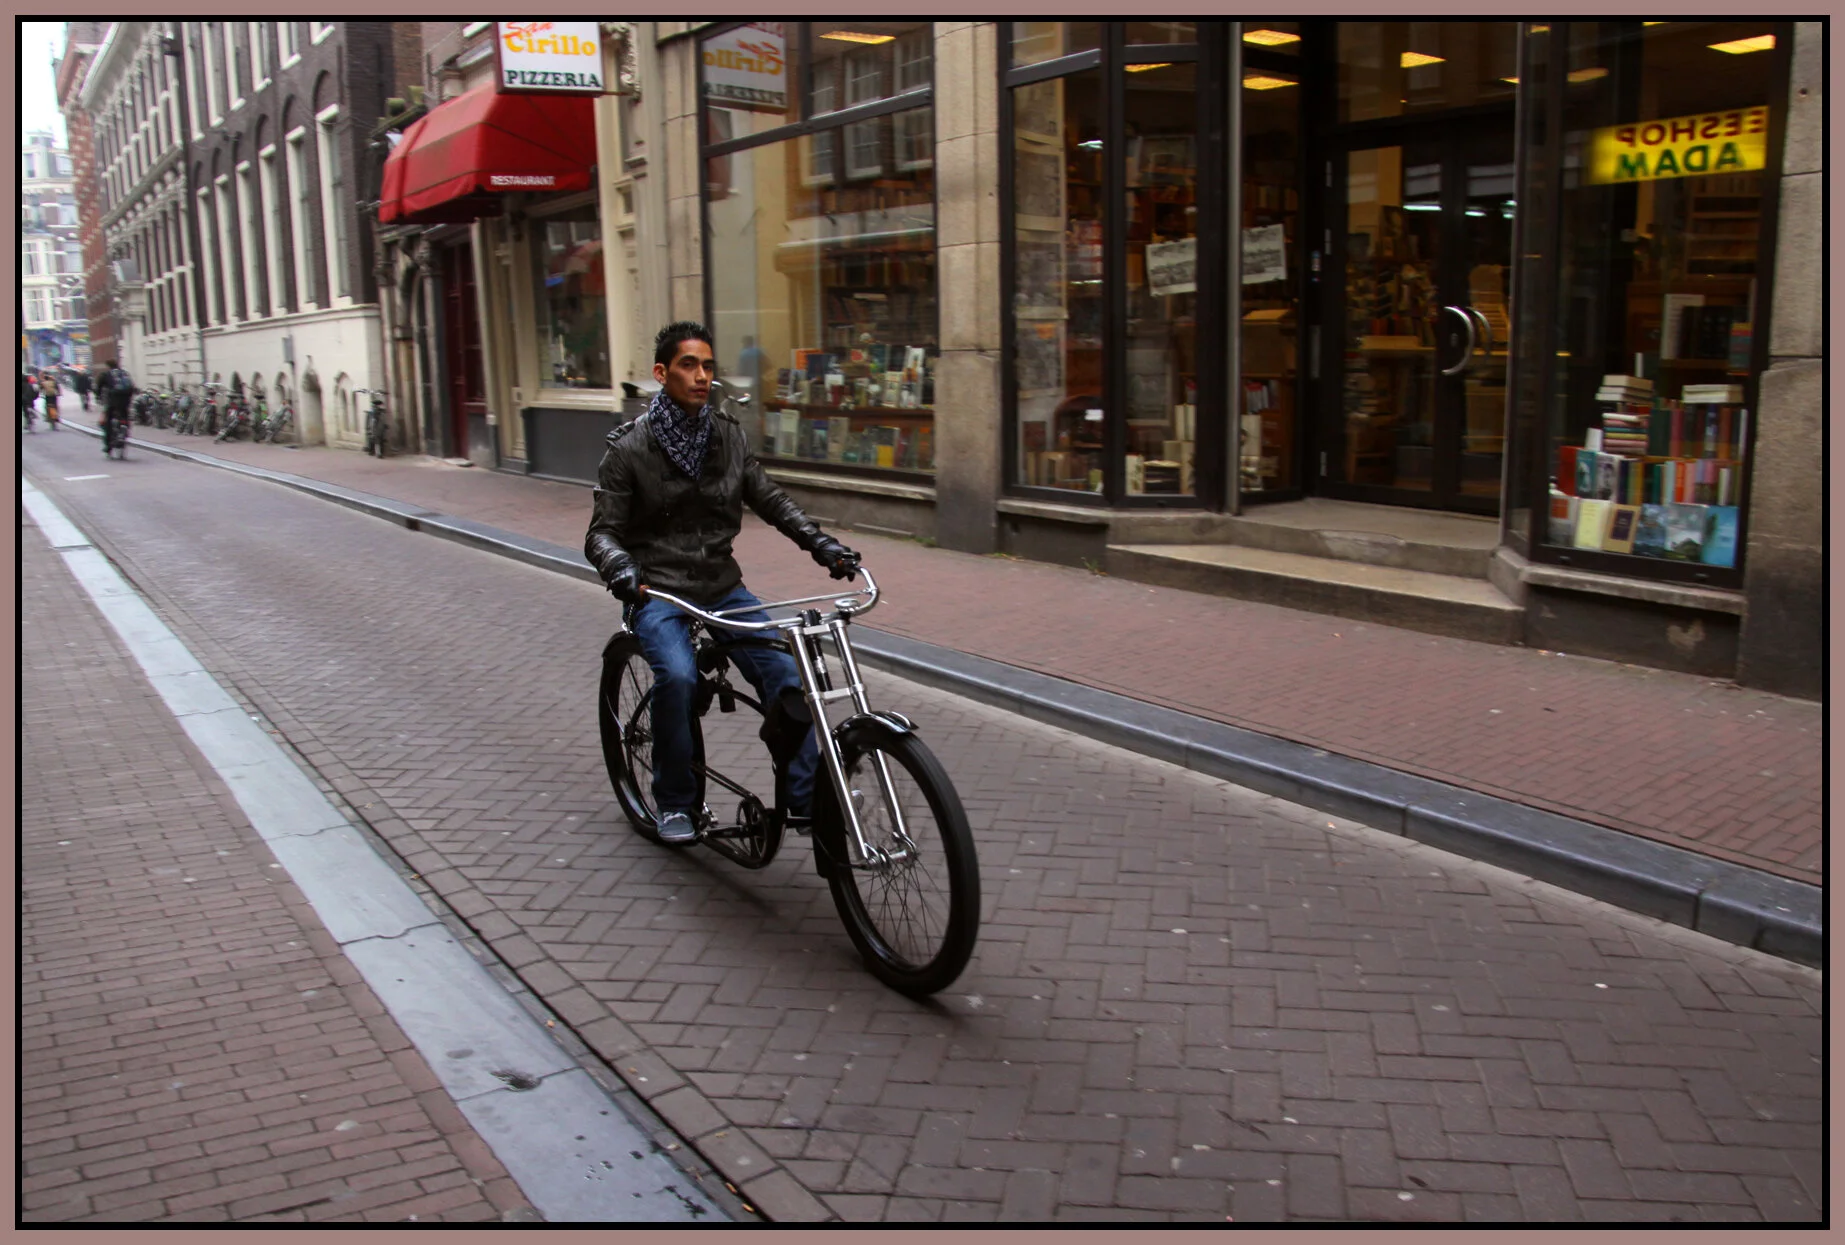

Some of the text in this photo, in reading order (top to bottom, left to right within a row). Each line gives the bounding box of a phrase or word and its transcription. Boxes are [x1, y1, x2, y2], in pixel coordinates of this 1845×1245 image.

[505, 31, 597, 56] Cirillo
[504, 69, 603, 88] PIZZERIA
[490, 175, 555, 186] RESTAURANT
